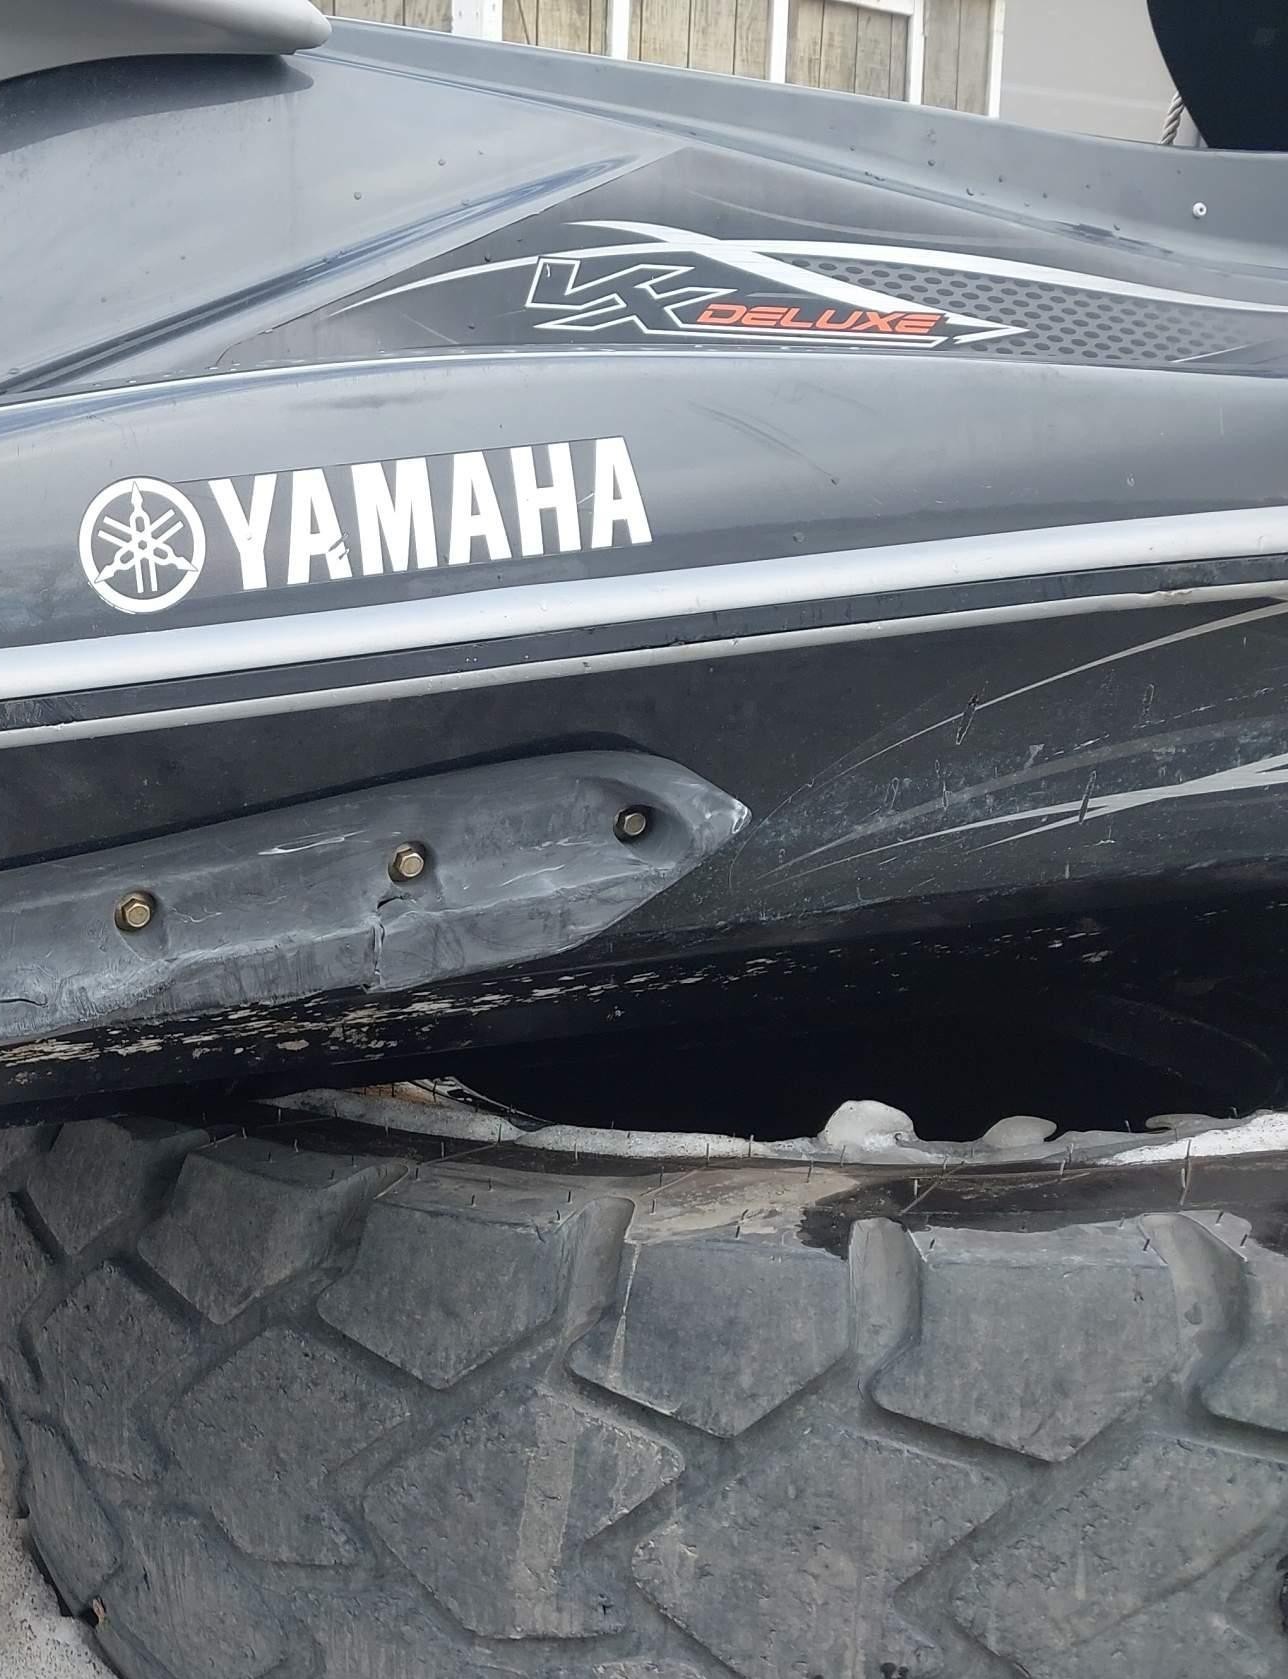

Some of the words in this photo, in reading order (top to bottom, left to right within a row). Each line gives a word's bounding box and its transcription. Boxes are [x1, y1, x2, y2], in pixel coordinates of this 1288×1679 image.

[525, 255, 738, 334] VX
[696, 302, 946, 334] DELUXE
[208, 436, 653, 591] YAMAHA
